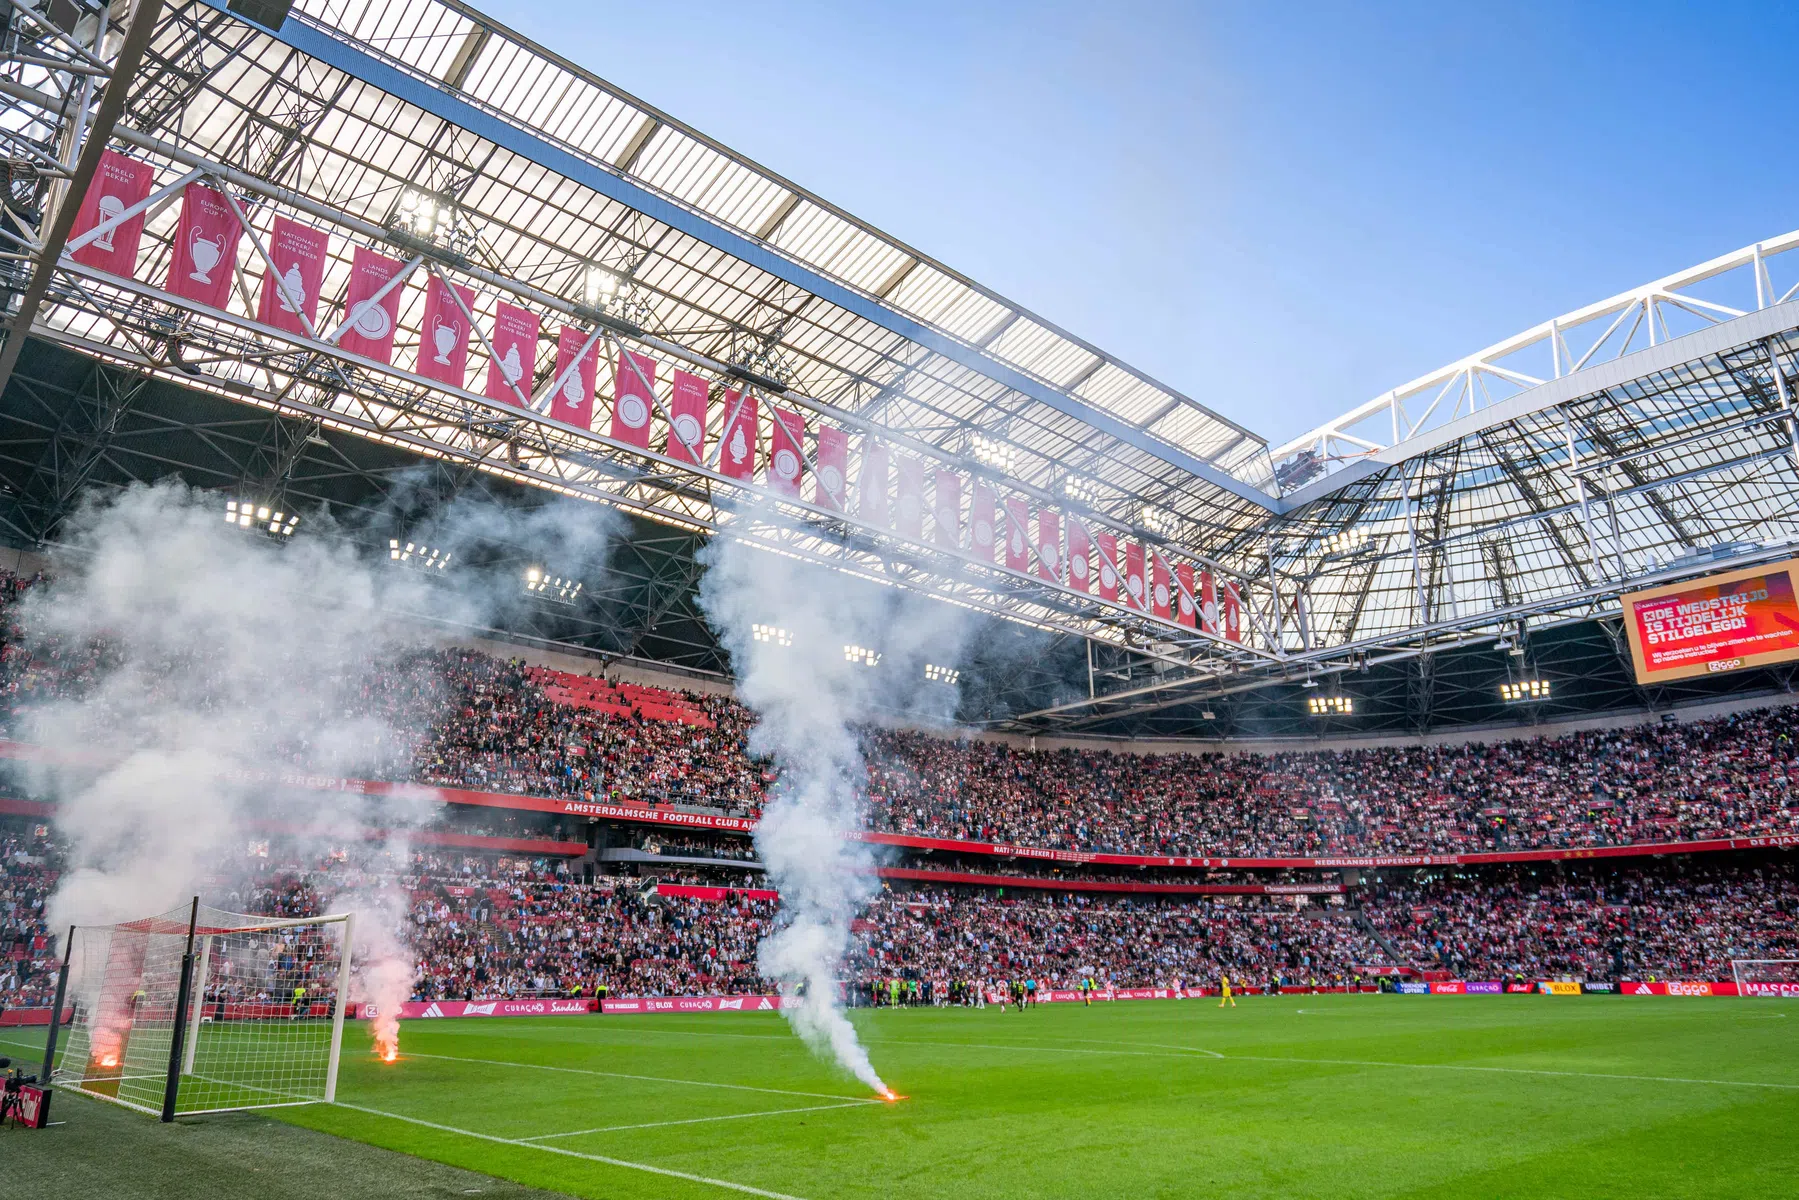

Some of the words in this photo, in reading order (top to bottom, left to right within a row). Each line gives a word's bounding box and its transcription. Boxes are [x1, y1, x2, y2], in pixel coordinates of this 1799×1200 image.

[103, 163, 135, 179] WERELD
[105, 171, 129, 184] BEKER
[200, 199, 228, 214] EUROPA
[204, 207, 219, 216] CUP
[281, 230, 319, 249] NATIONALE
[297, 249, 318, 260] BEKER
[368, 263, 389, 275] LANDS
[502, 313, 532, 329] NATIONALE
[1656, 607, 1674, 620] DE
[1676, 589, 1769, 616] WEDSTRIJD
[1645, 621, 1664, 633] IS
[1666, 605, 1748, 629] TIJDELIJK
[1648, 617, 1747, 645] STILGELEGD!
[565, 803, 658, 820] AMSTERDAMSCHE
[663, 812, 712, 825] FOOTBALL
[715, 818, 739, 827] CLUB
[1376, 857, 1422, 865] SUPERCUP
[655, 1001, 674, 1009] BLOX
